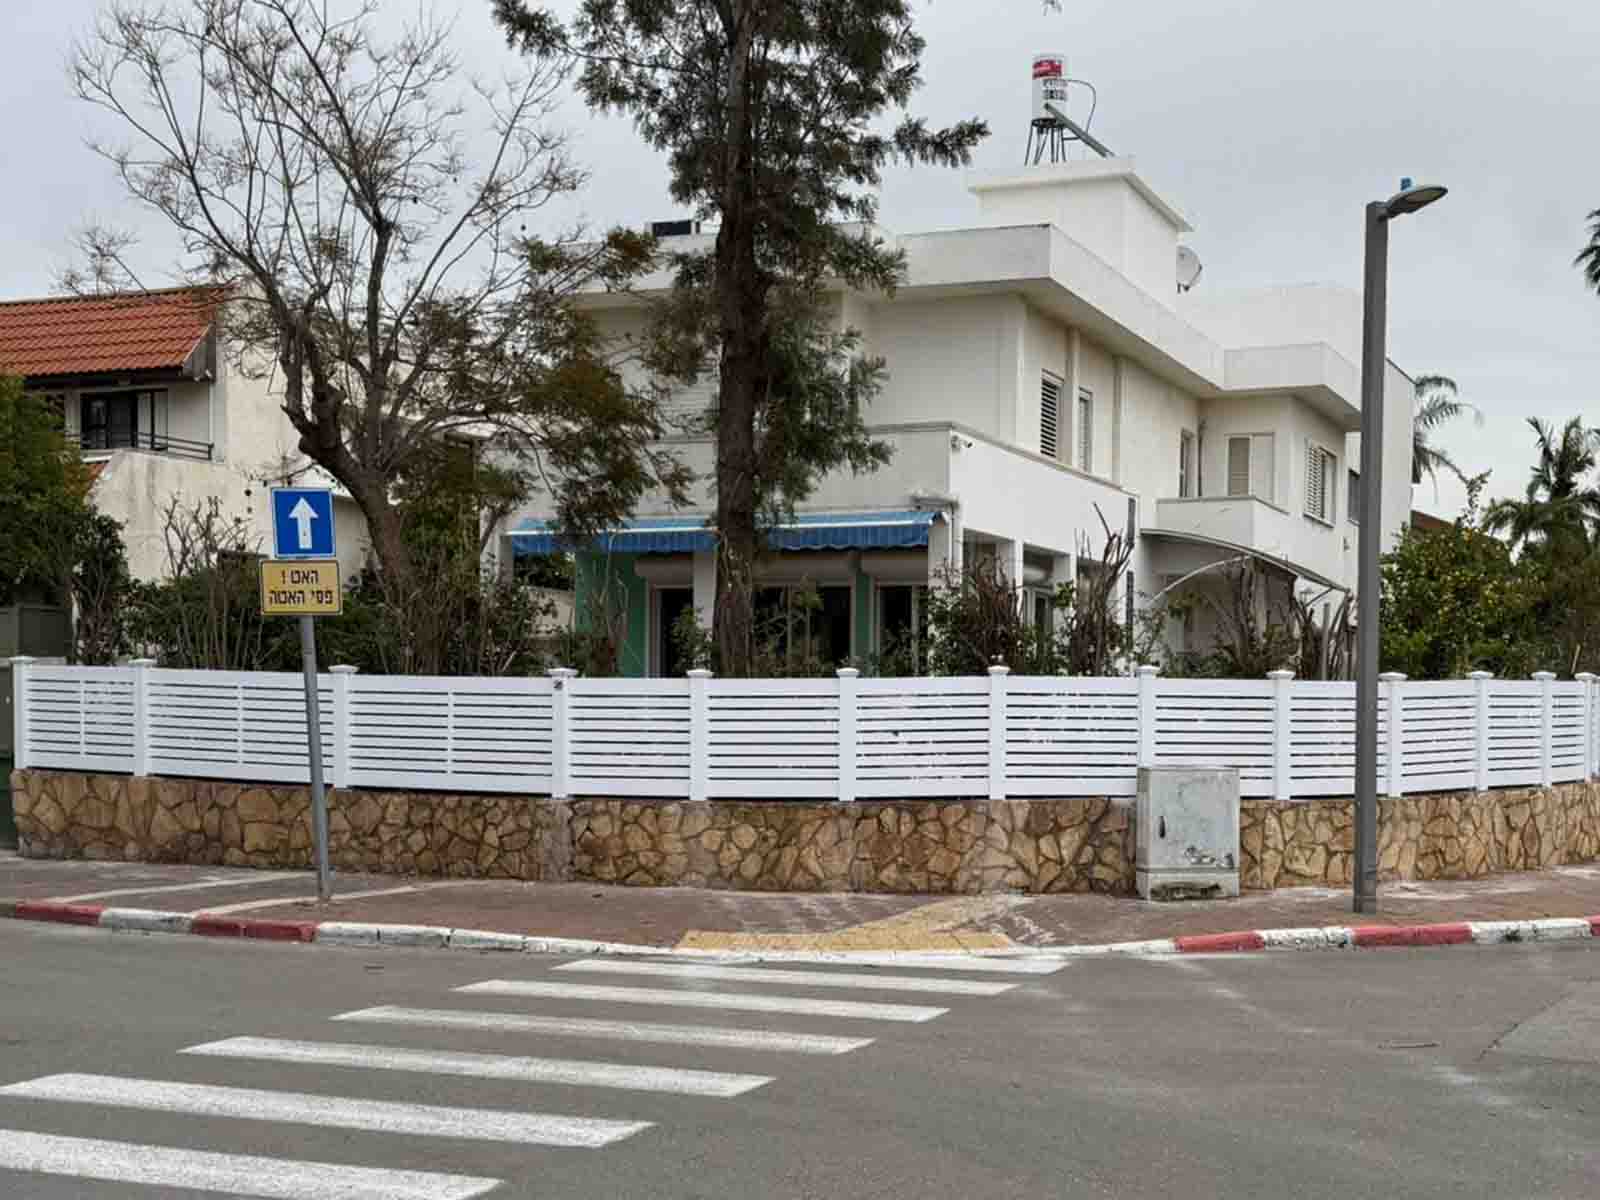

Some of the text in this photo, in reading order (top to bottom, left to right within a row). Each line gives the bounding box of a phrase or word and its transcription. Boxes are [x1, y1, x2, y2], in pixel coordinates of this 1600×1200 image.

[290, 570, 319, 585] האט
[269, 589, 334, 605] פסי האטה
